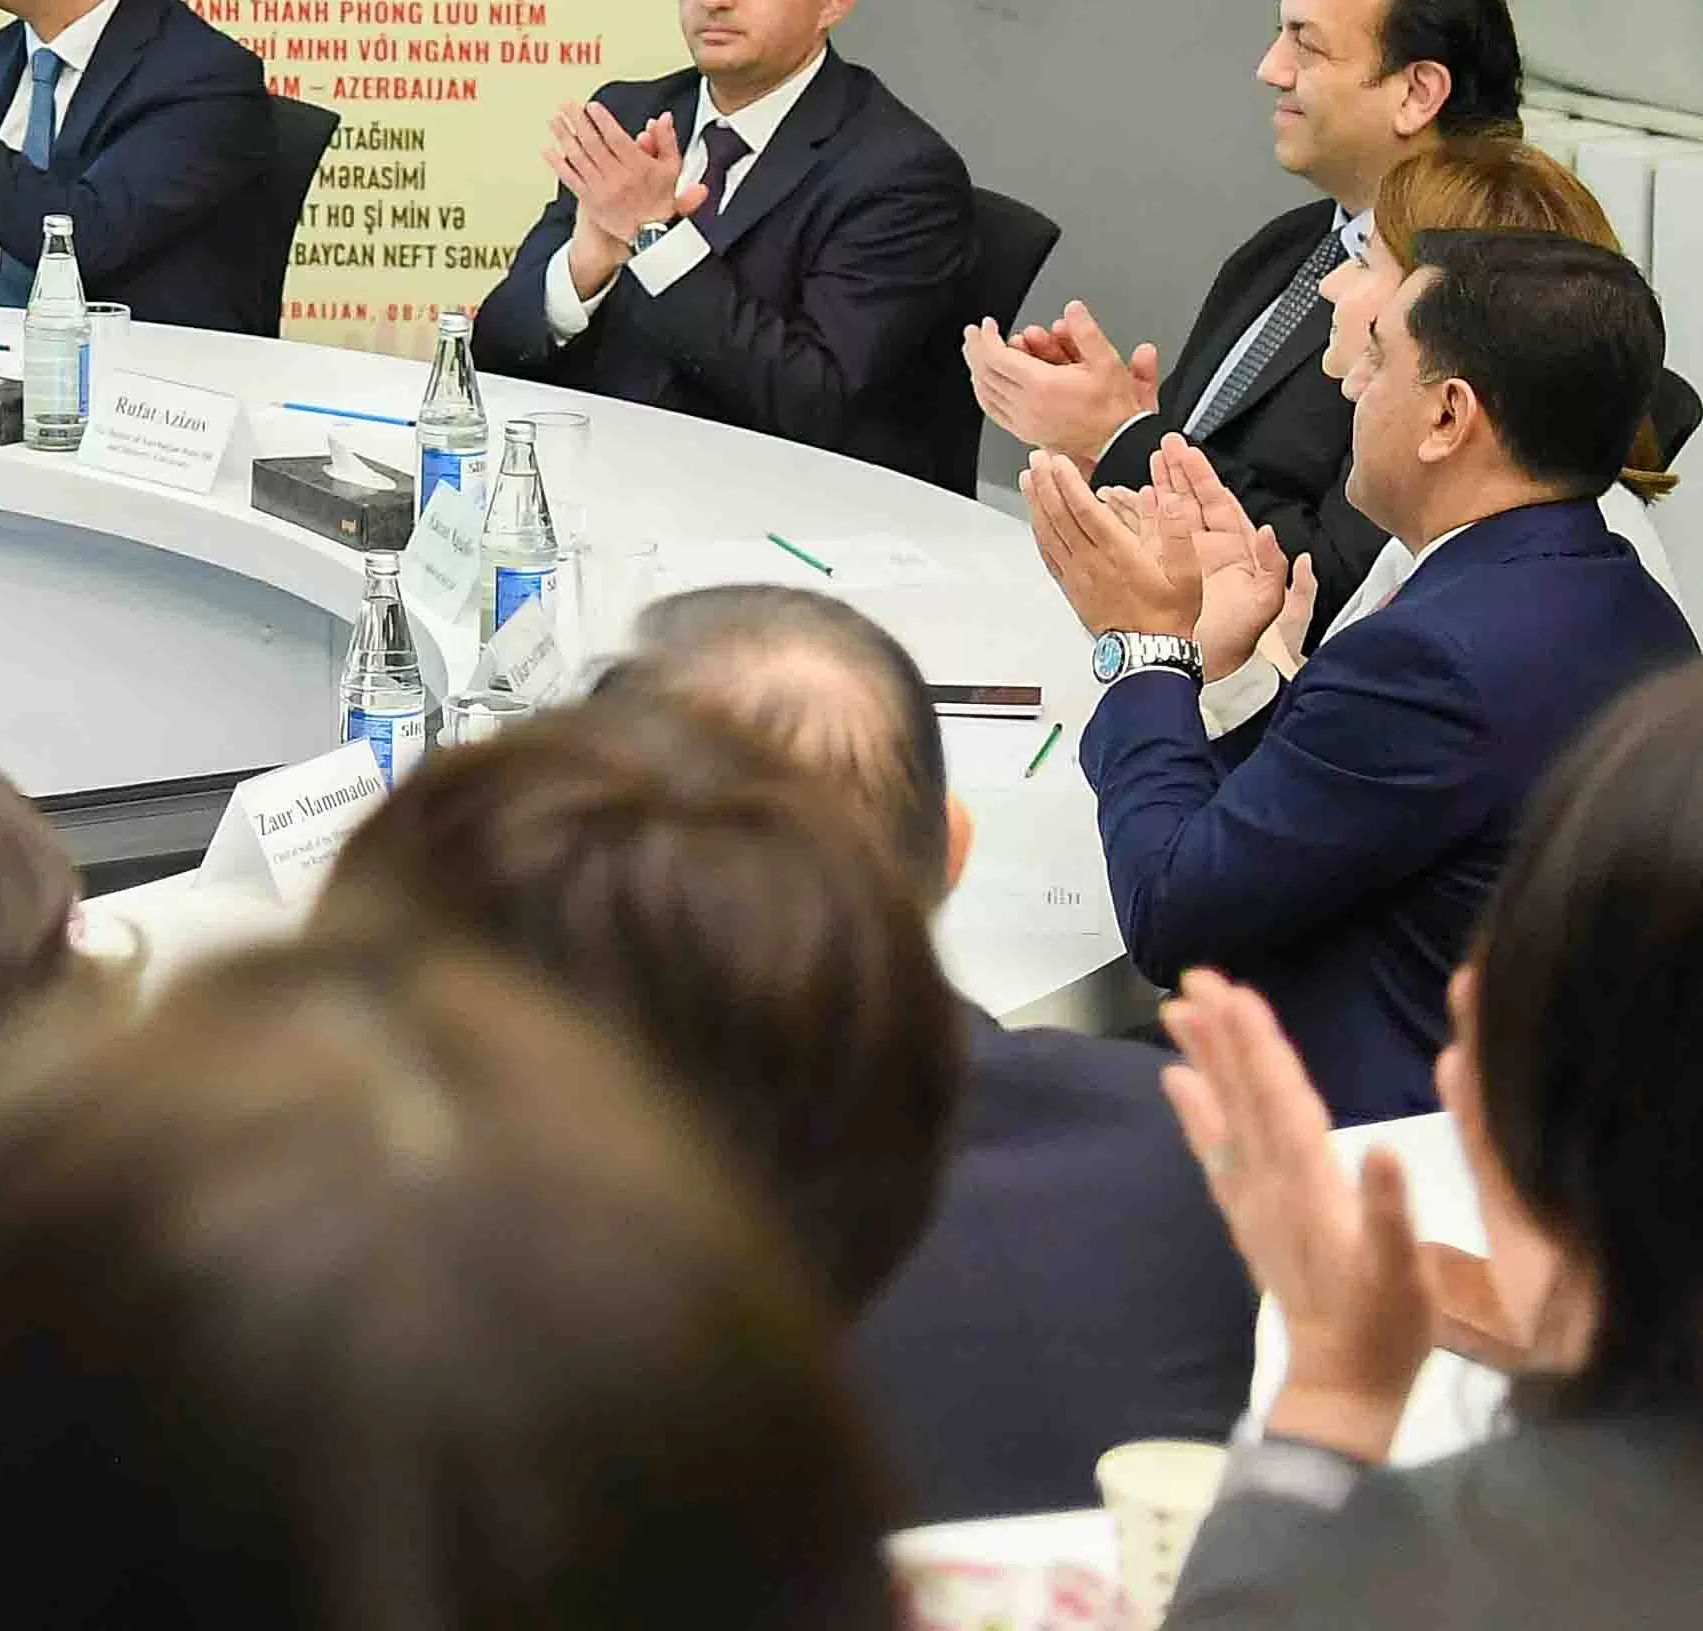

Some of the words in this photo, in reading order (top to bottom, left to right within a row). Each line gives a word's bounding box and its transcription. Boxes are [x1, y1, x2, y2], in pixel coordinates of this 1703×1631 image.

[287, 39, 347, 62] MINH
[333, 76, 477, 101] AZERBAIJAN
[326, 204, 355, 229] HO
[293, 243, 375, 267] BAYCAN
[383, 244, 437, 269] NEFT
[444, 245, 516, 270] SƏNAY
[257, 807, 295, 836] Zaur
[296, 775, 382, 818] Mammadov
